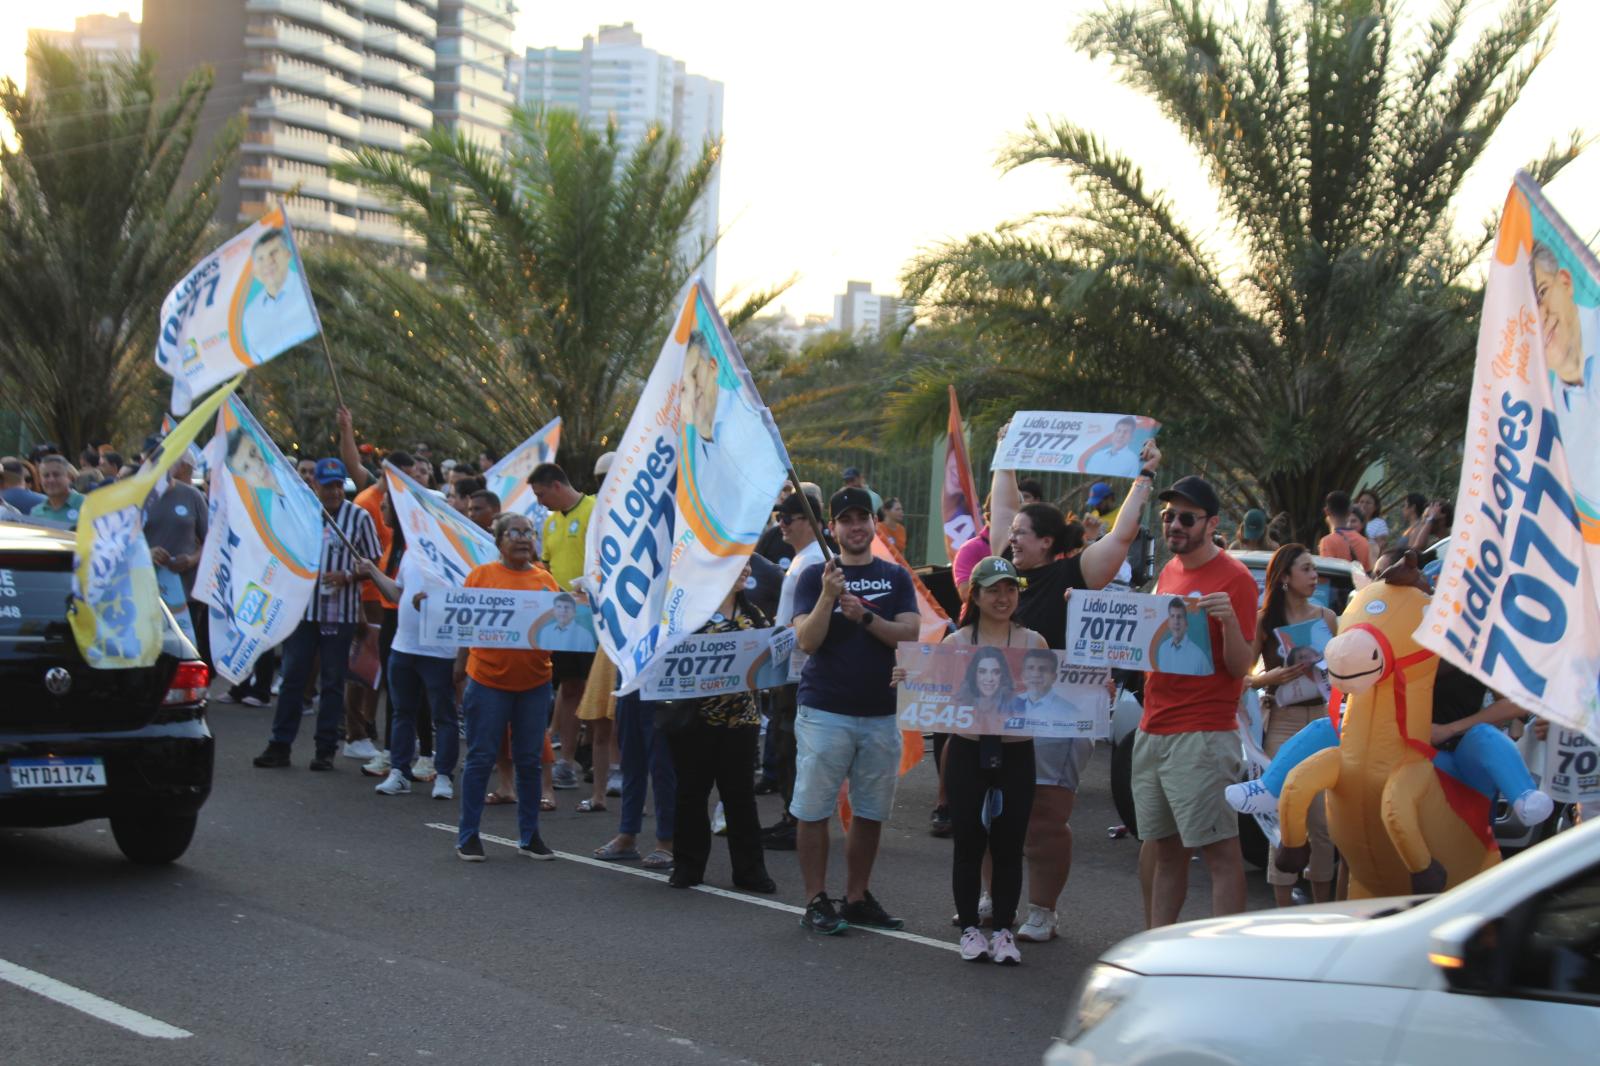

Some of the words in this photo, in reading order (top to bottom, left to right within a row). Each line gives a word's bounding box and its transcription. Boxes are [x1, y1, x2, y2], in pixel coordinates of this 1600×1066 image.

[1023, 417, 1047, 429] Lidio
[1050, 418, 1083, 433] Lopes
[1014, 431, 1079, 450] 70777
[608, 436, 675, 538] Lopes
[1431, 514, 1475, 635] DEPUTADO
[1468, 383, 1492, 497] ESTADUAL
[1445, 538, 1503, 664] Lidio
[1480, 391, 1533, 538] Lopes
[239, 589, 263, 625] 222
[445, 592, 475, 605] Lidio
[479, 594, 515, 608] Lopes
[1082, 598, 1107, 613] Lidio
[1109, 599, 1138, 617] Lopes
[443, 607, 515, 626] 70777
[1079, 617, 1138, 642] 70777
[700, 640, 736, 654] Lopes
[664, 654, 736, 676] 70777
[904, 680, 953, 692] Viviane
[1060, 670, 1108, 684] 70777
[900, 703, 975, 728] 4545
